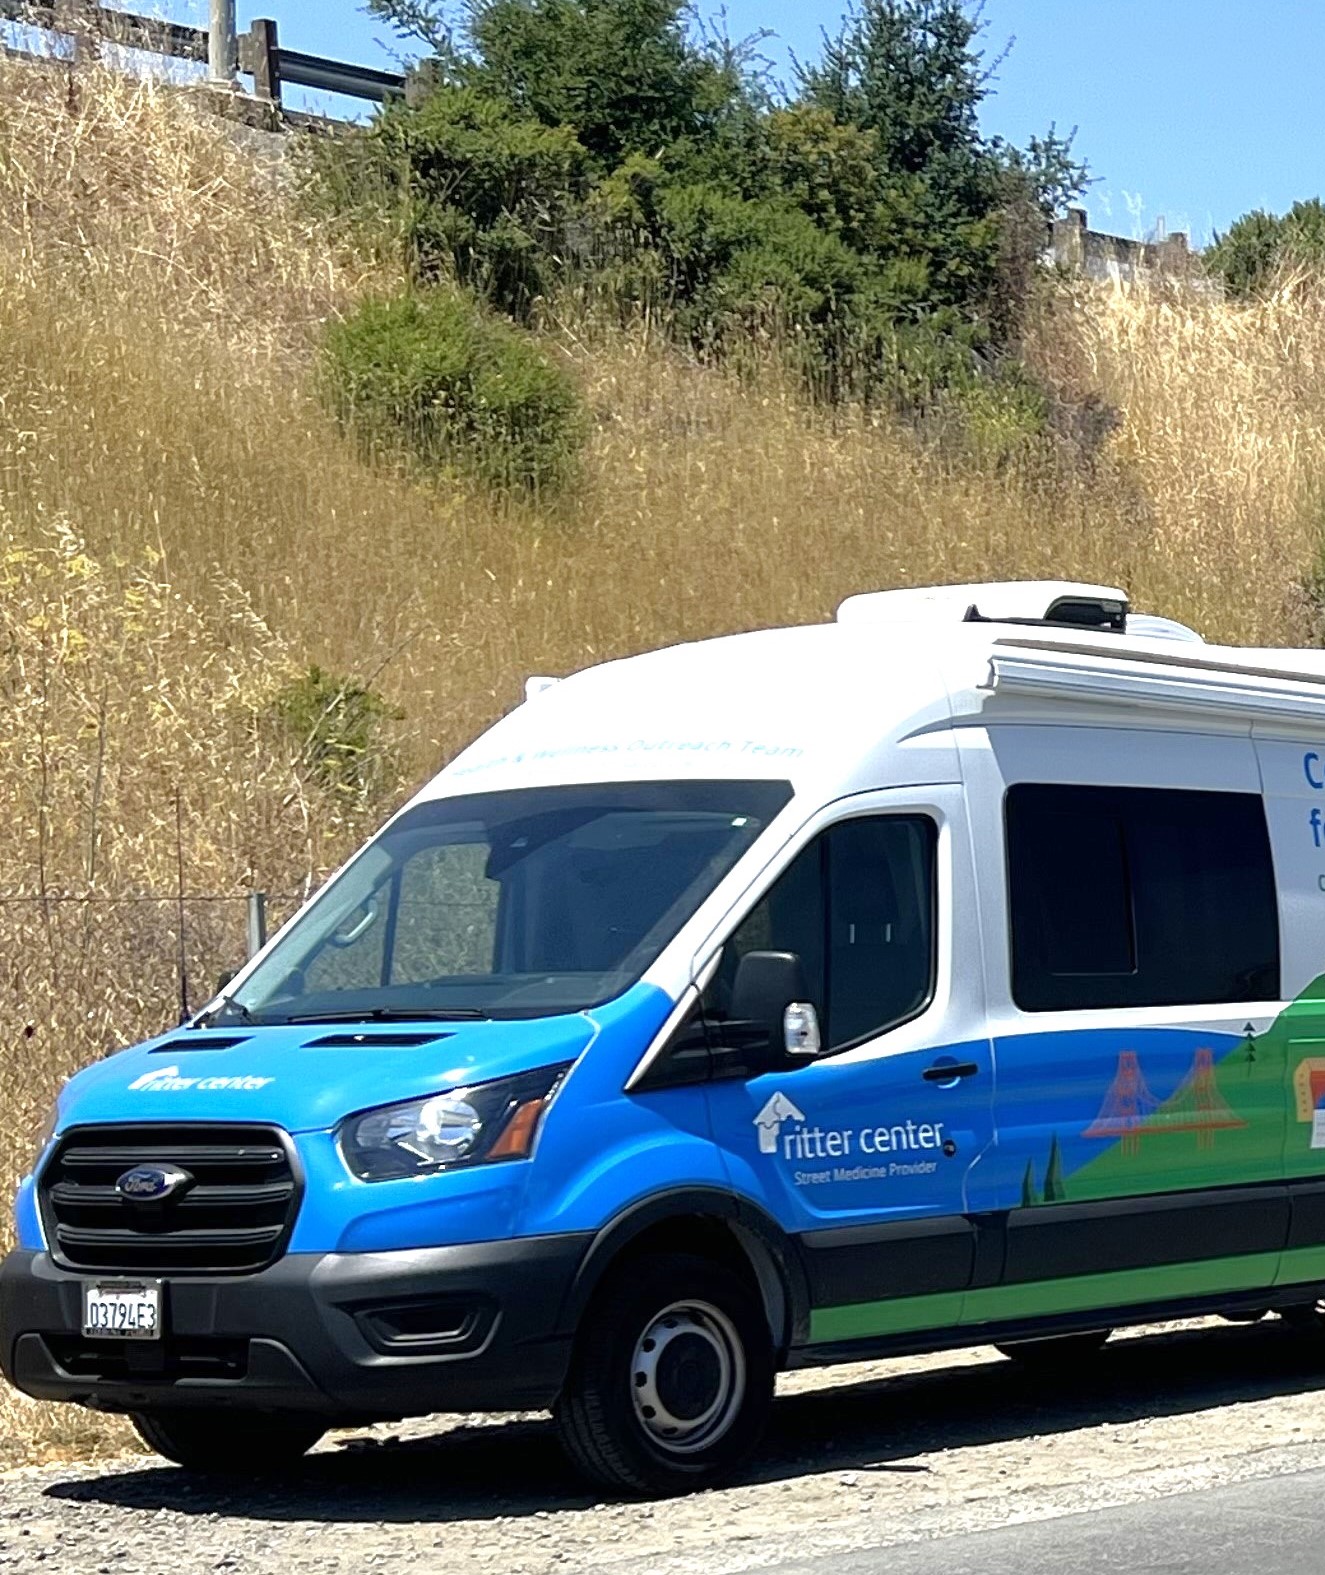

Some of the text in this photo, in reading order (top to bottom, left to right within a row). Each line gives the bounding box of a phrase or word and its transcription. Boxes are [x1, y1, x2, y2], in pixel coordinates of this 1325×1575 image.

[740, 740, 804, 757] Team
[196, 1074, 276, 1090] center
[784, 1119, 944, 1160] ritter center
[124, 1173, 158, 1192] Ford
[794, 1160, 938, 1186] Street Medicine Provider
[90, 1302, 156, 1329] 03794E3
